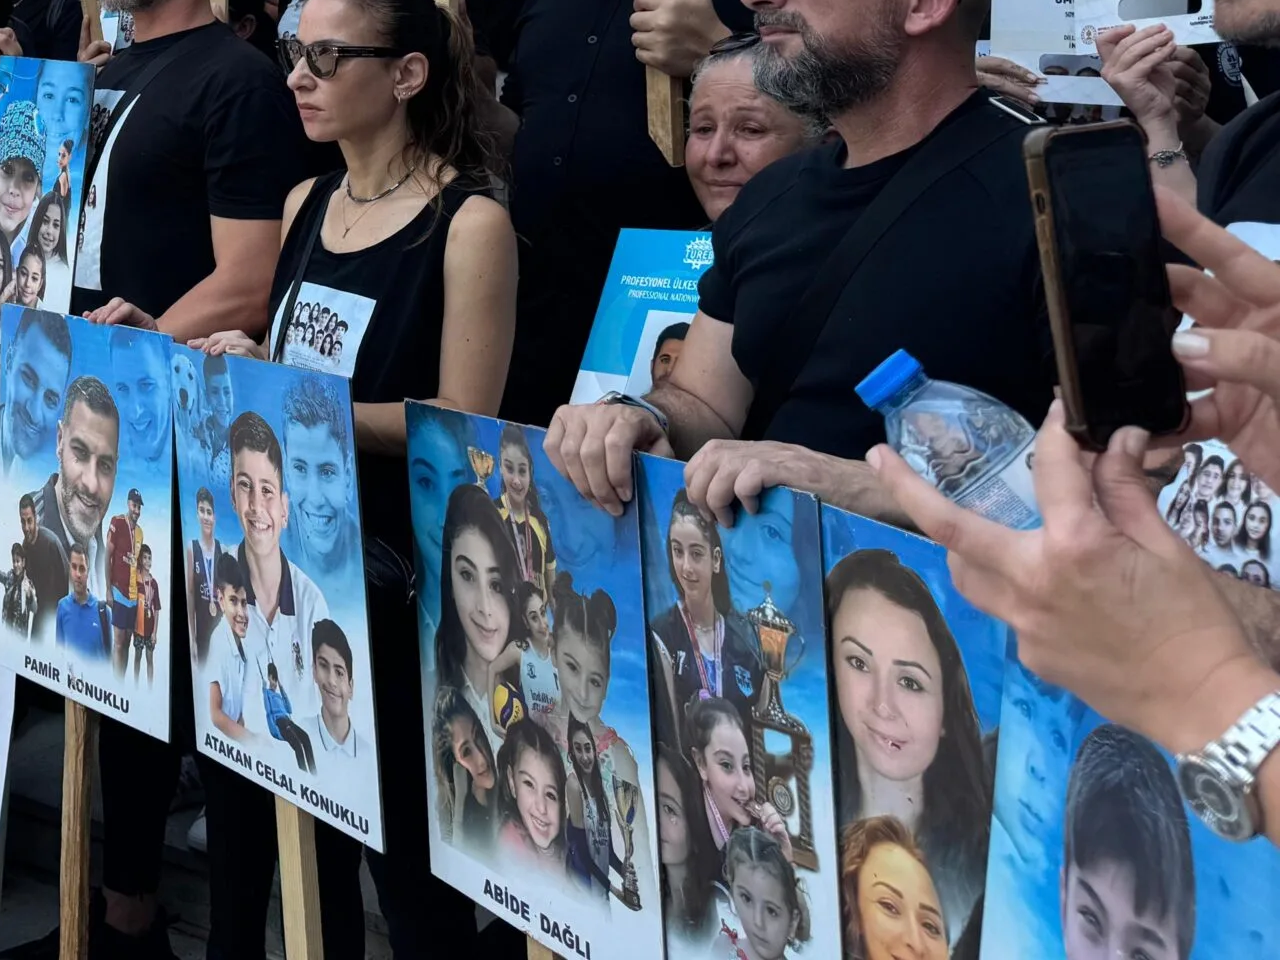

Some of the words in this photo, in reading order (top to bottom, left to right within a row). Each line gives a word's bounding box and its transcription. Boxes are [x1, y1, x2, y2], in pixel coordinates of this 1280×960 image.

[620, 275, 671, 289] PROFESYONEL
[628, 289, 669, 301] PROFESSIONAL
[24, 655, 60, 683] PAMİR
[67, 674, 130, 713] KONUKLU
[204, 732, 253, 771] ATAKAN
[256, 759, 297, 795] CELAL
[300, 783, 370, 835] KONUKLU
[483, 878, 530, 922] ABİDE
[540, 913, 591, 960] DAĞLI
